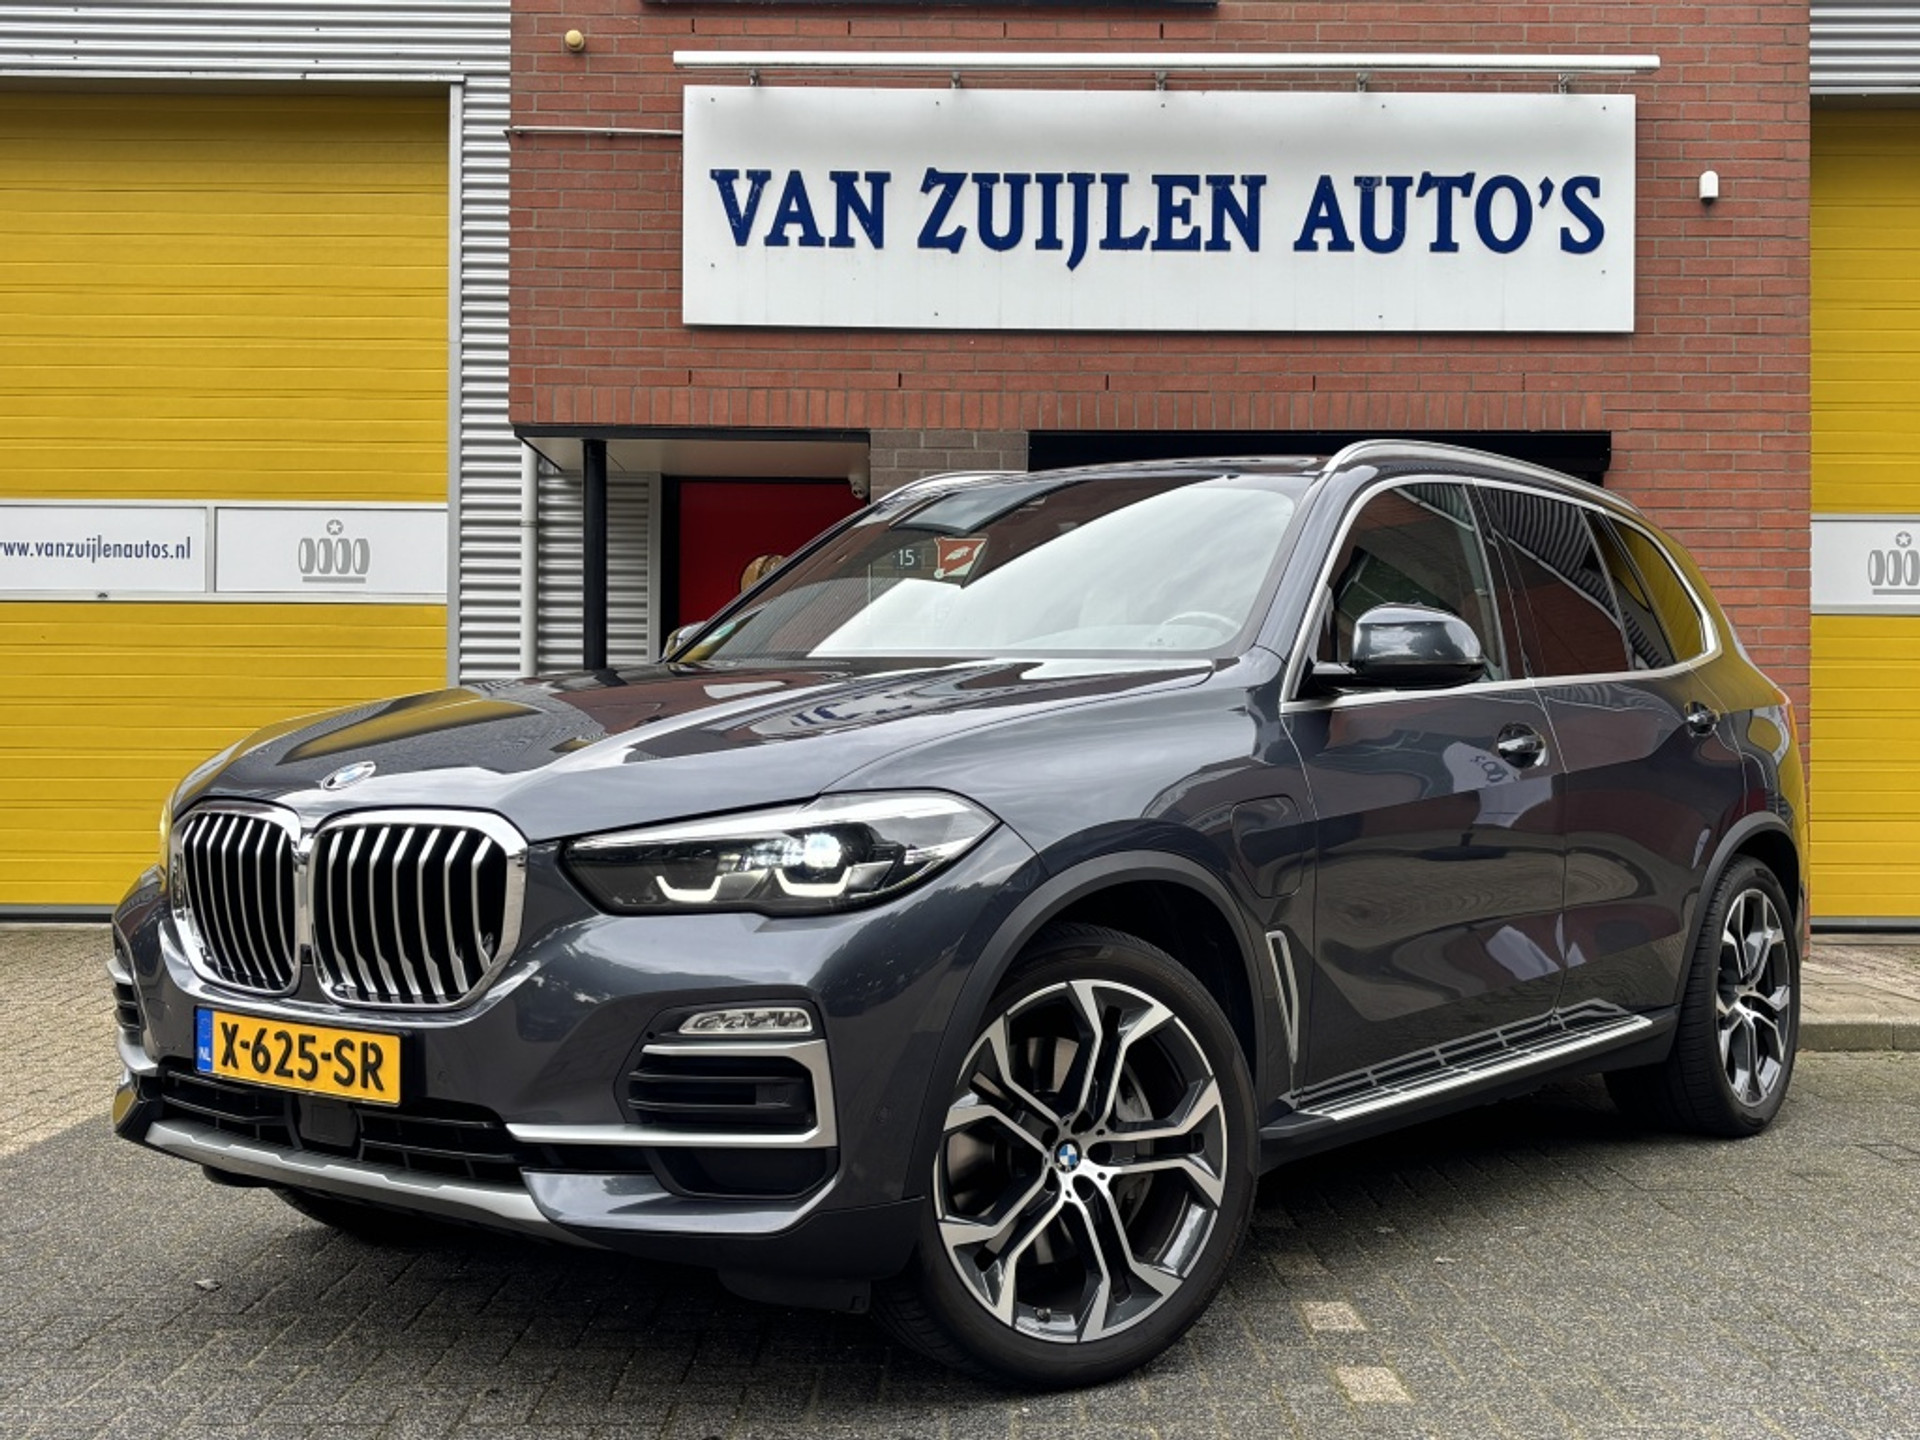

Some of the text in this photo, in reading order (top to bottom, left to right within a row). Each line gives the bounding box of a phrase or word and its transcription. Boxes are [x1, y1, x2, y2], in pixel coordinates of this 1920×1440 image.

[709, 167, 1606, 272] VAN ZUIJLEN AUTO'S
[0, 536, 191, 563] ww.vanzuijlenautos.nl
[898, 549, 915, 566] 15
[199, 1046, 212, 1062] NL
[220, 1021, 385, 1092] X-625-SR
